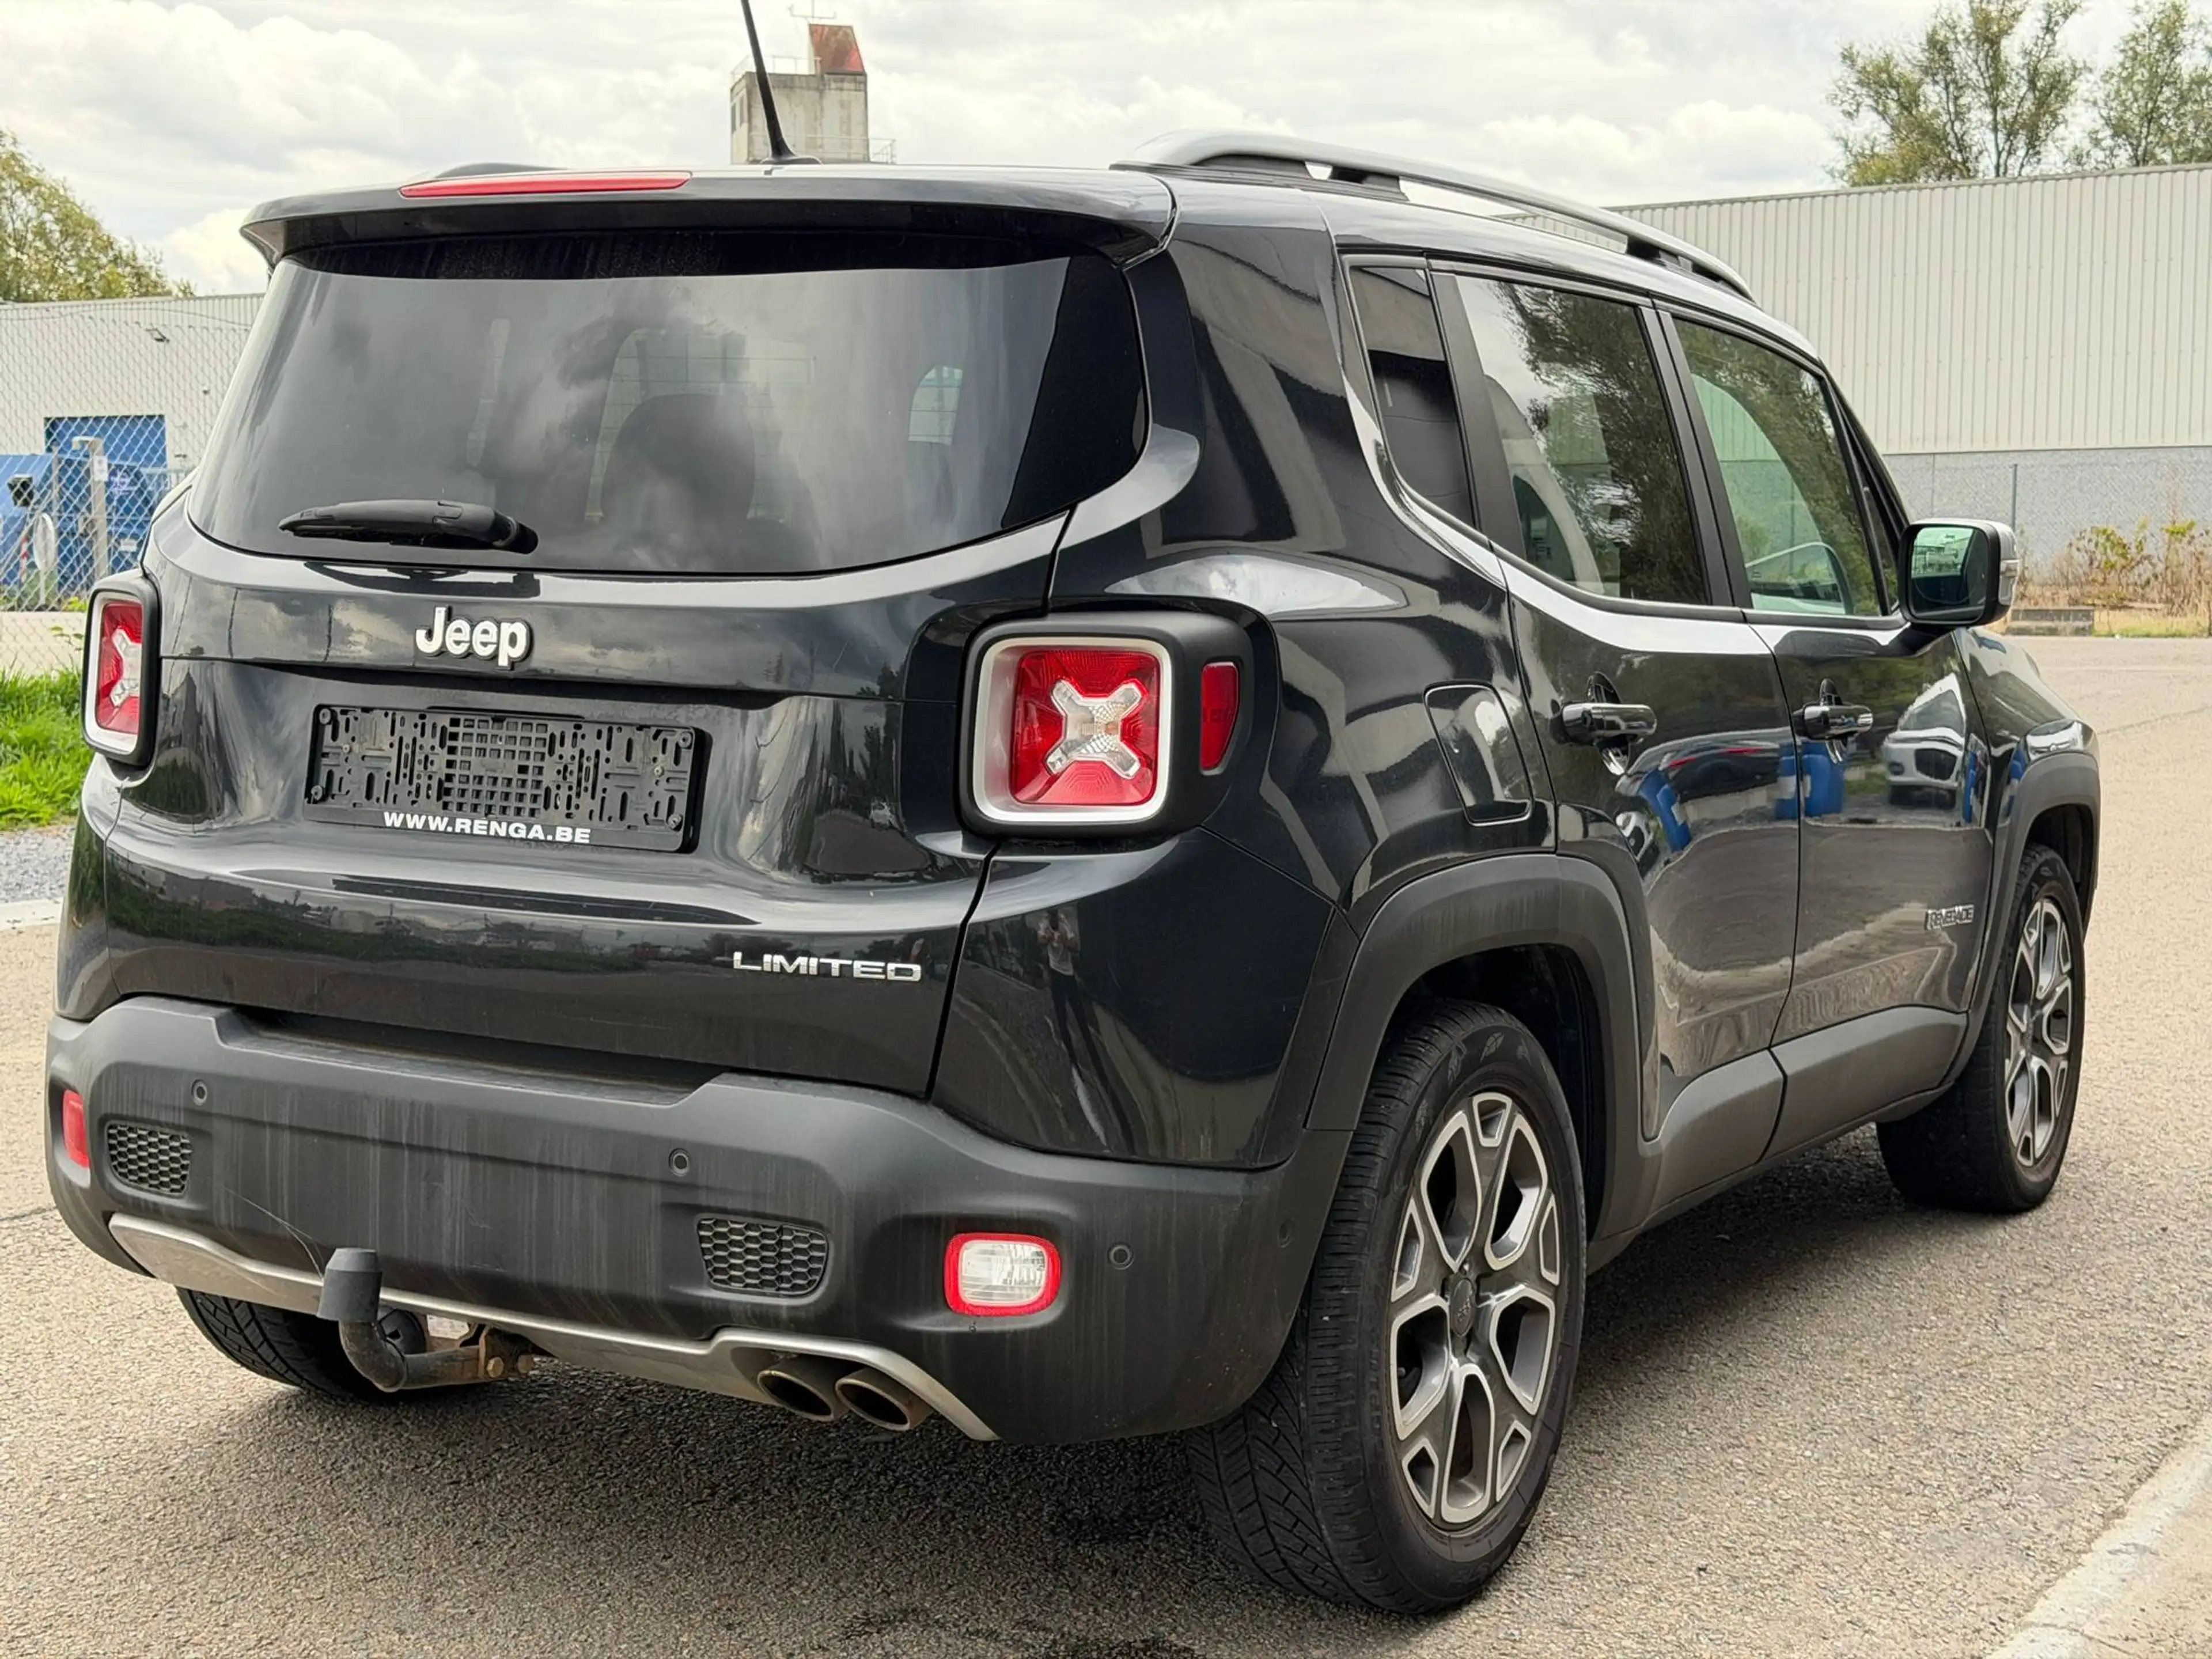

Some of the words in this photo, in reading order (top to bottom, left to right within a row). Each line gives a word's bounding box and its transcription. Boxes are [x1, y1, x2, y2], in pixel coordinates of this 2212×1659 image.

[415, 607, 529, 666] Jeep
[384, 811, 591, 843] WWW.RENGA.BE
[733, 951, 922, 982] LIMITED
